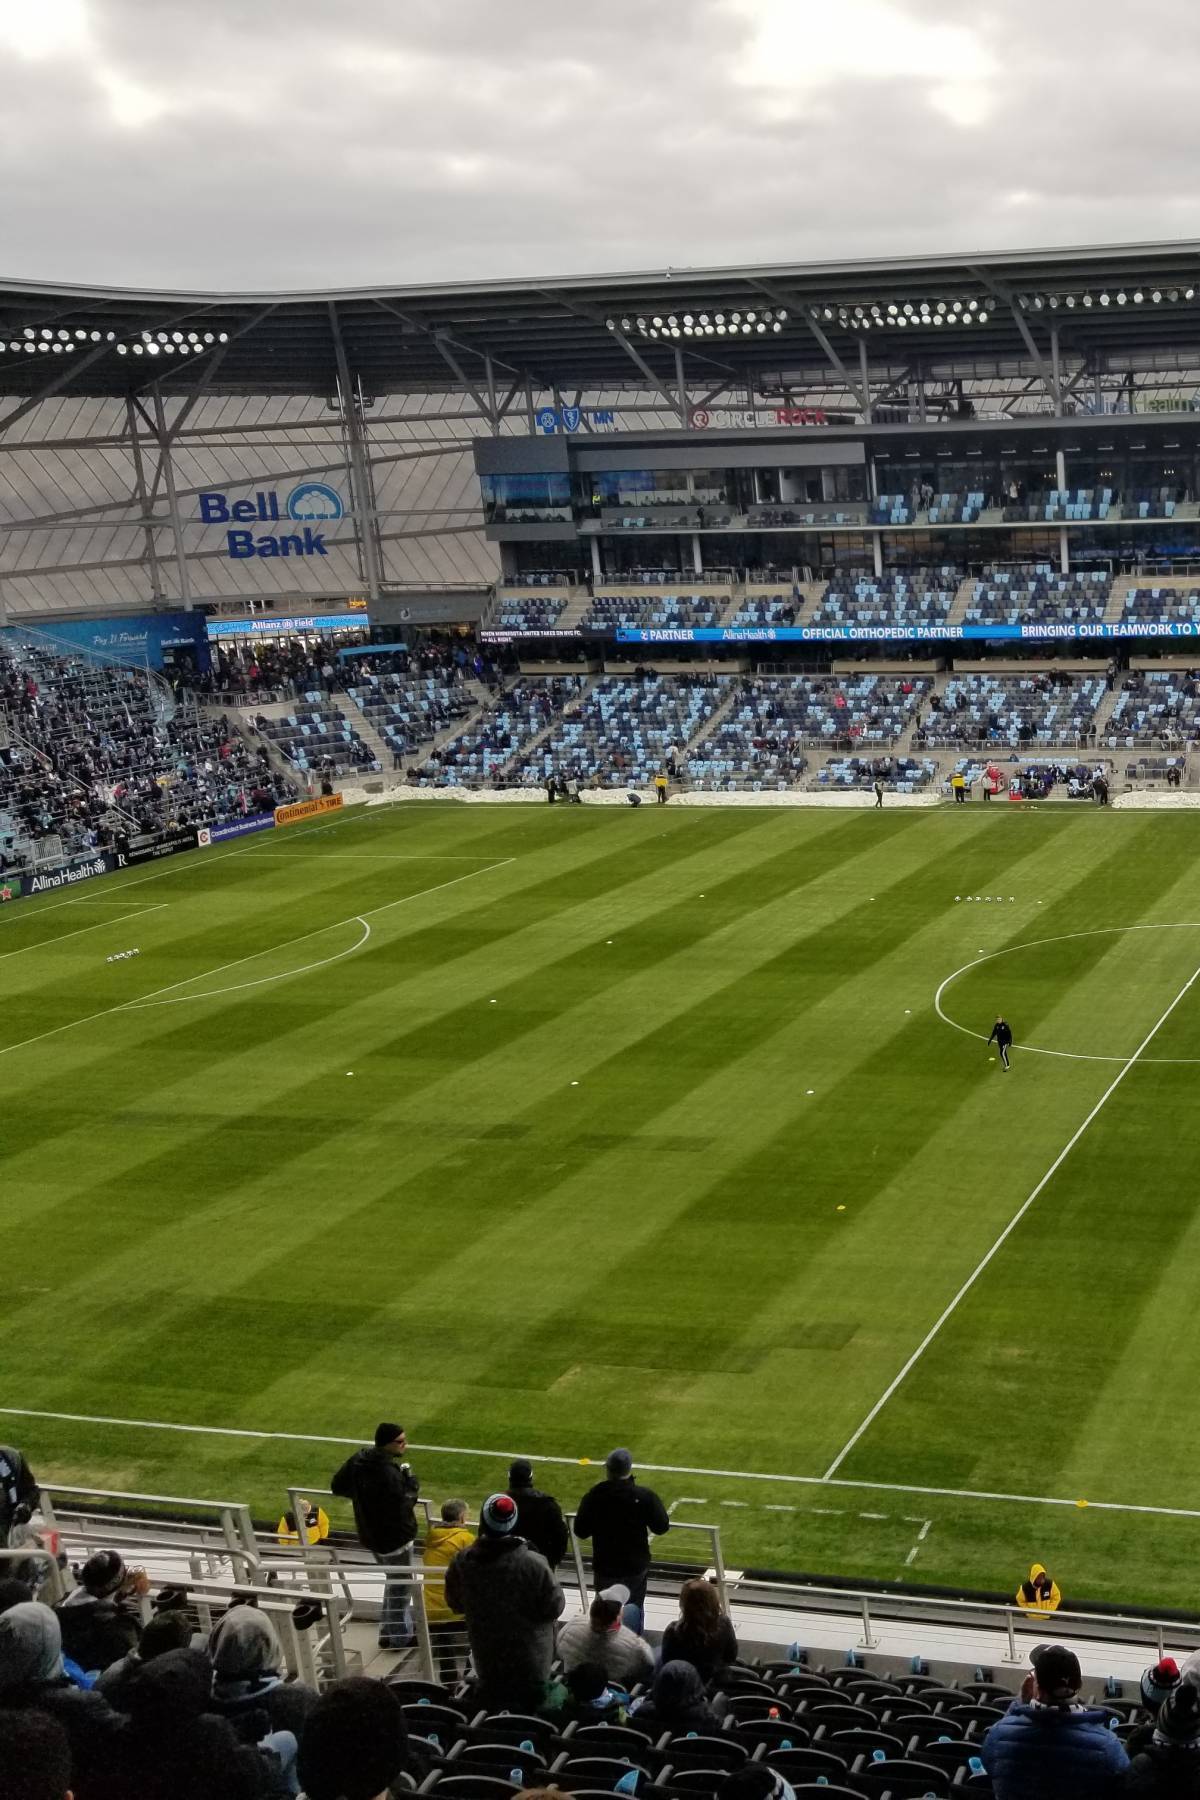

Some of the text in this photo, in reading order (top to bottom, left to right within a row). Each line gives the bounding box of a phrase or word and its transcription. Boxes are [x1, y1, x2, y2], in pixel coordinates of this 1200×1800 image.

[593, 410, 614, 425] MN
[199, 491, 280, 524] Bell
[227, 527, 328, 559] Bank
[251, 618, 314, 630] Allianz Field
[1021, 625, 1075, 637] BRINGING
[1081, 625, 1103, 637] OUR
[1106, 624, 1173, 636] TEAMWORK
[1176, 623, 1191, 635] TO
[650, 630, 694, 640] PARTNER
[802, 627, 963, 639] OFFICIAL ORTHOPEDIC PARTNER
[276, 797, 341, 824] Continental TIRE
[117, 853, 129, 867] R
